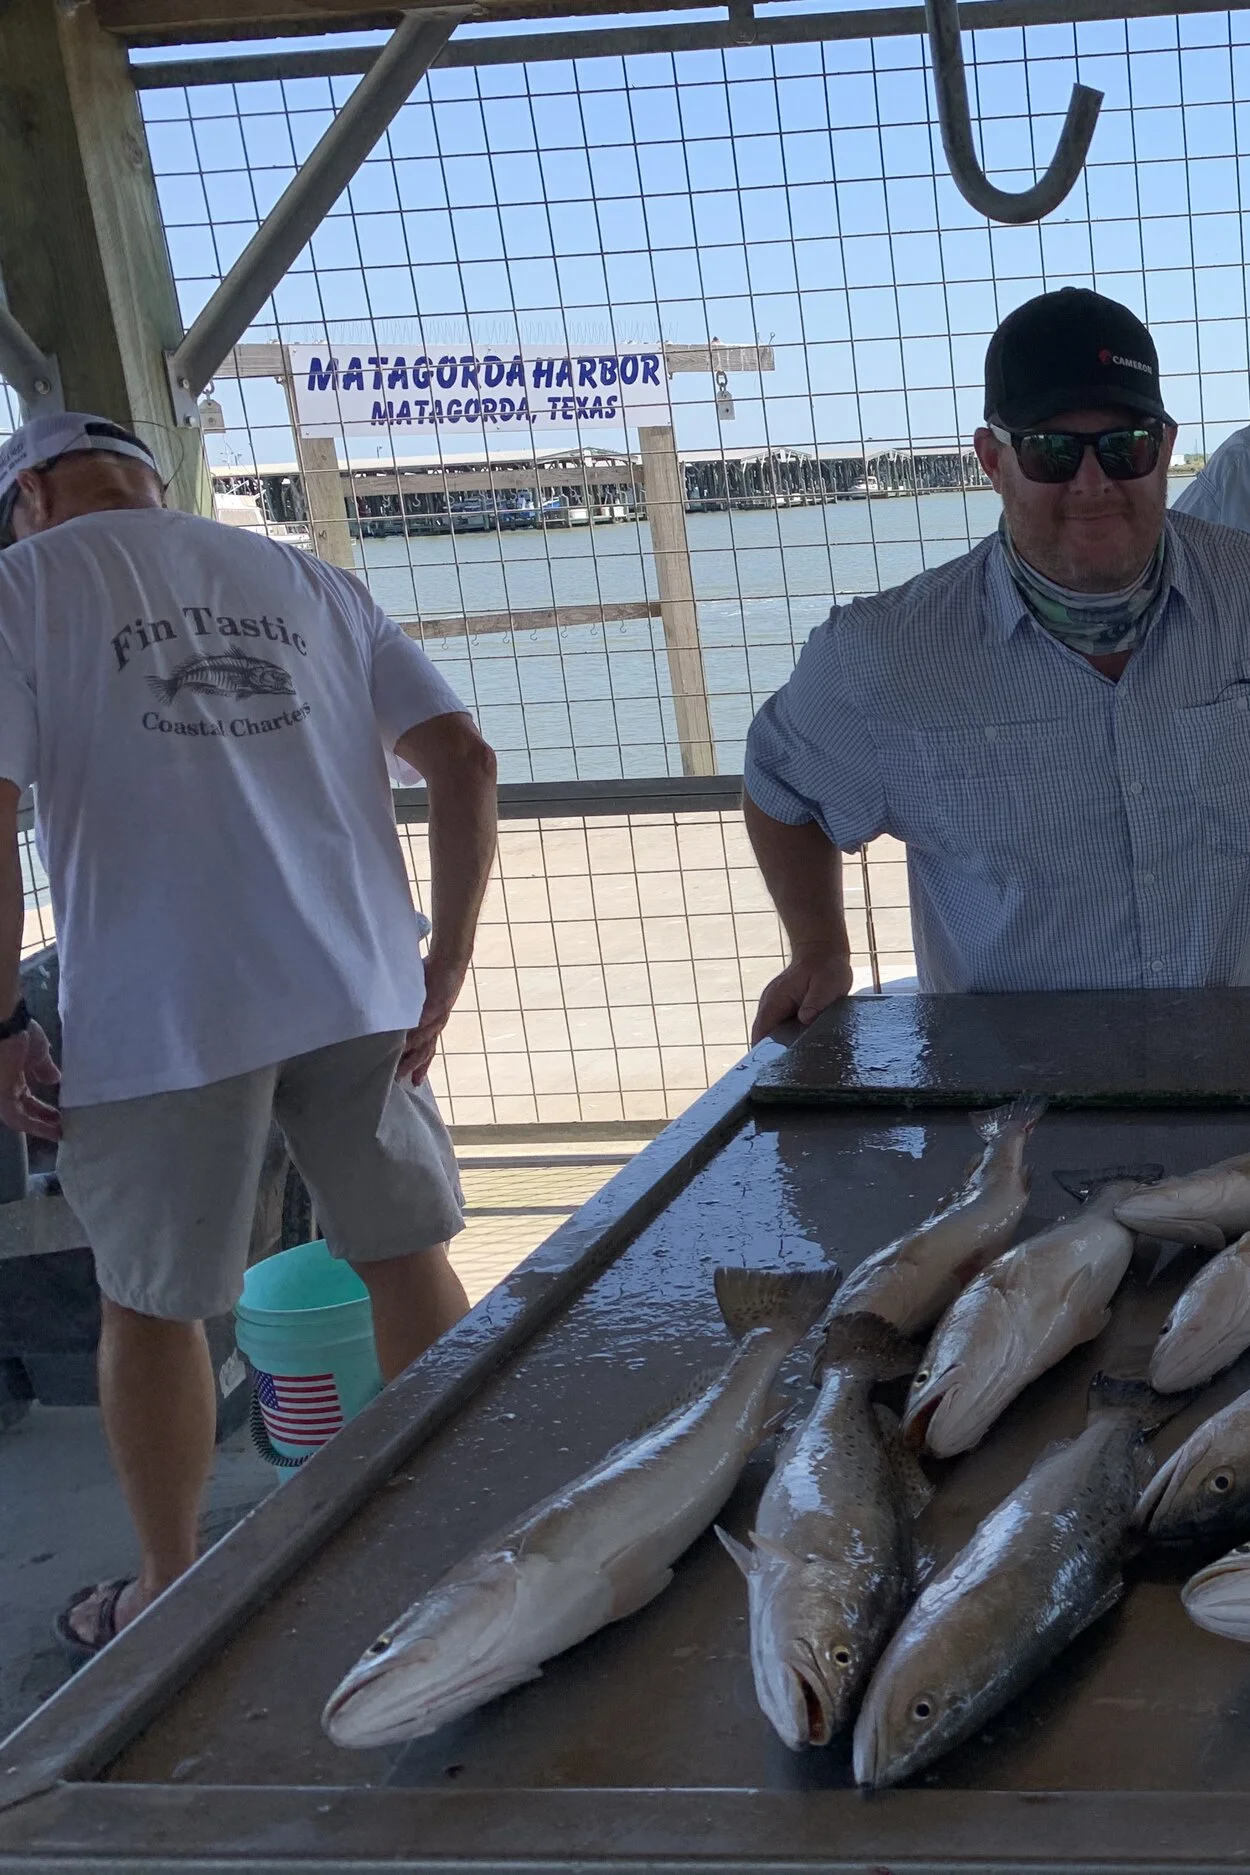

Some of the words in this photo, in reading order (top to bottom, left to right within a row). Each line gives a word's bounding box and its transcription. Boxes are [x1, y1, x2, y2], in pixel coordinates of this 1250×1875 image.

[307, 354, 524, 391] MATAGORDA
[532, 353, 662, 389] HARBOR
[1112, 355, 1153, 374] CAMERON
[370, 396, 538, 426] MATAGORDA,
[548, 395, 619, 420] TEXAS
[111, 618, 178, 672] Fin
[182, 607, 308, 656] Tastic
[142, 711, 225, 737] Coastal
[230, 702, 312, 737] Charters
